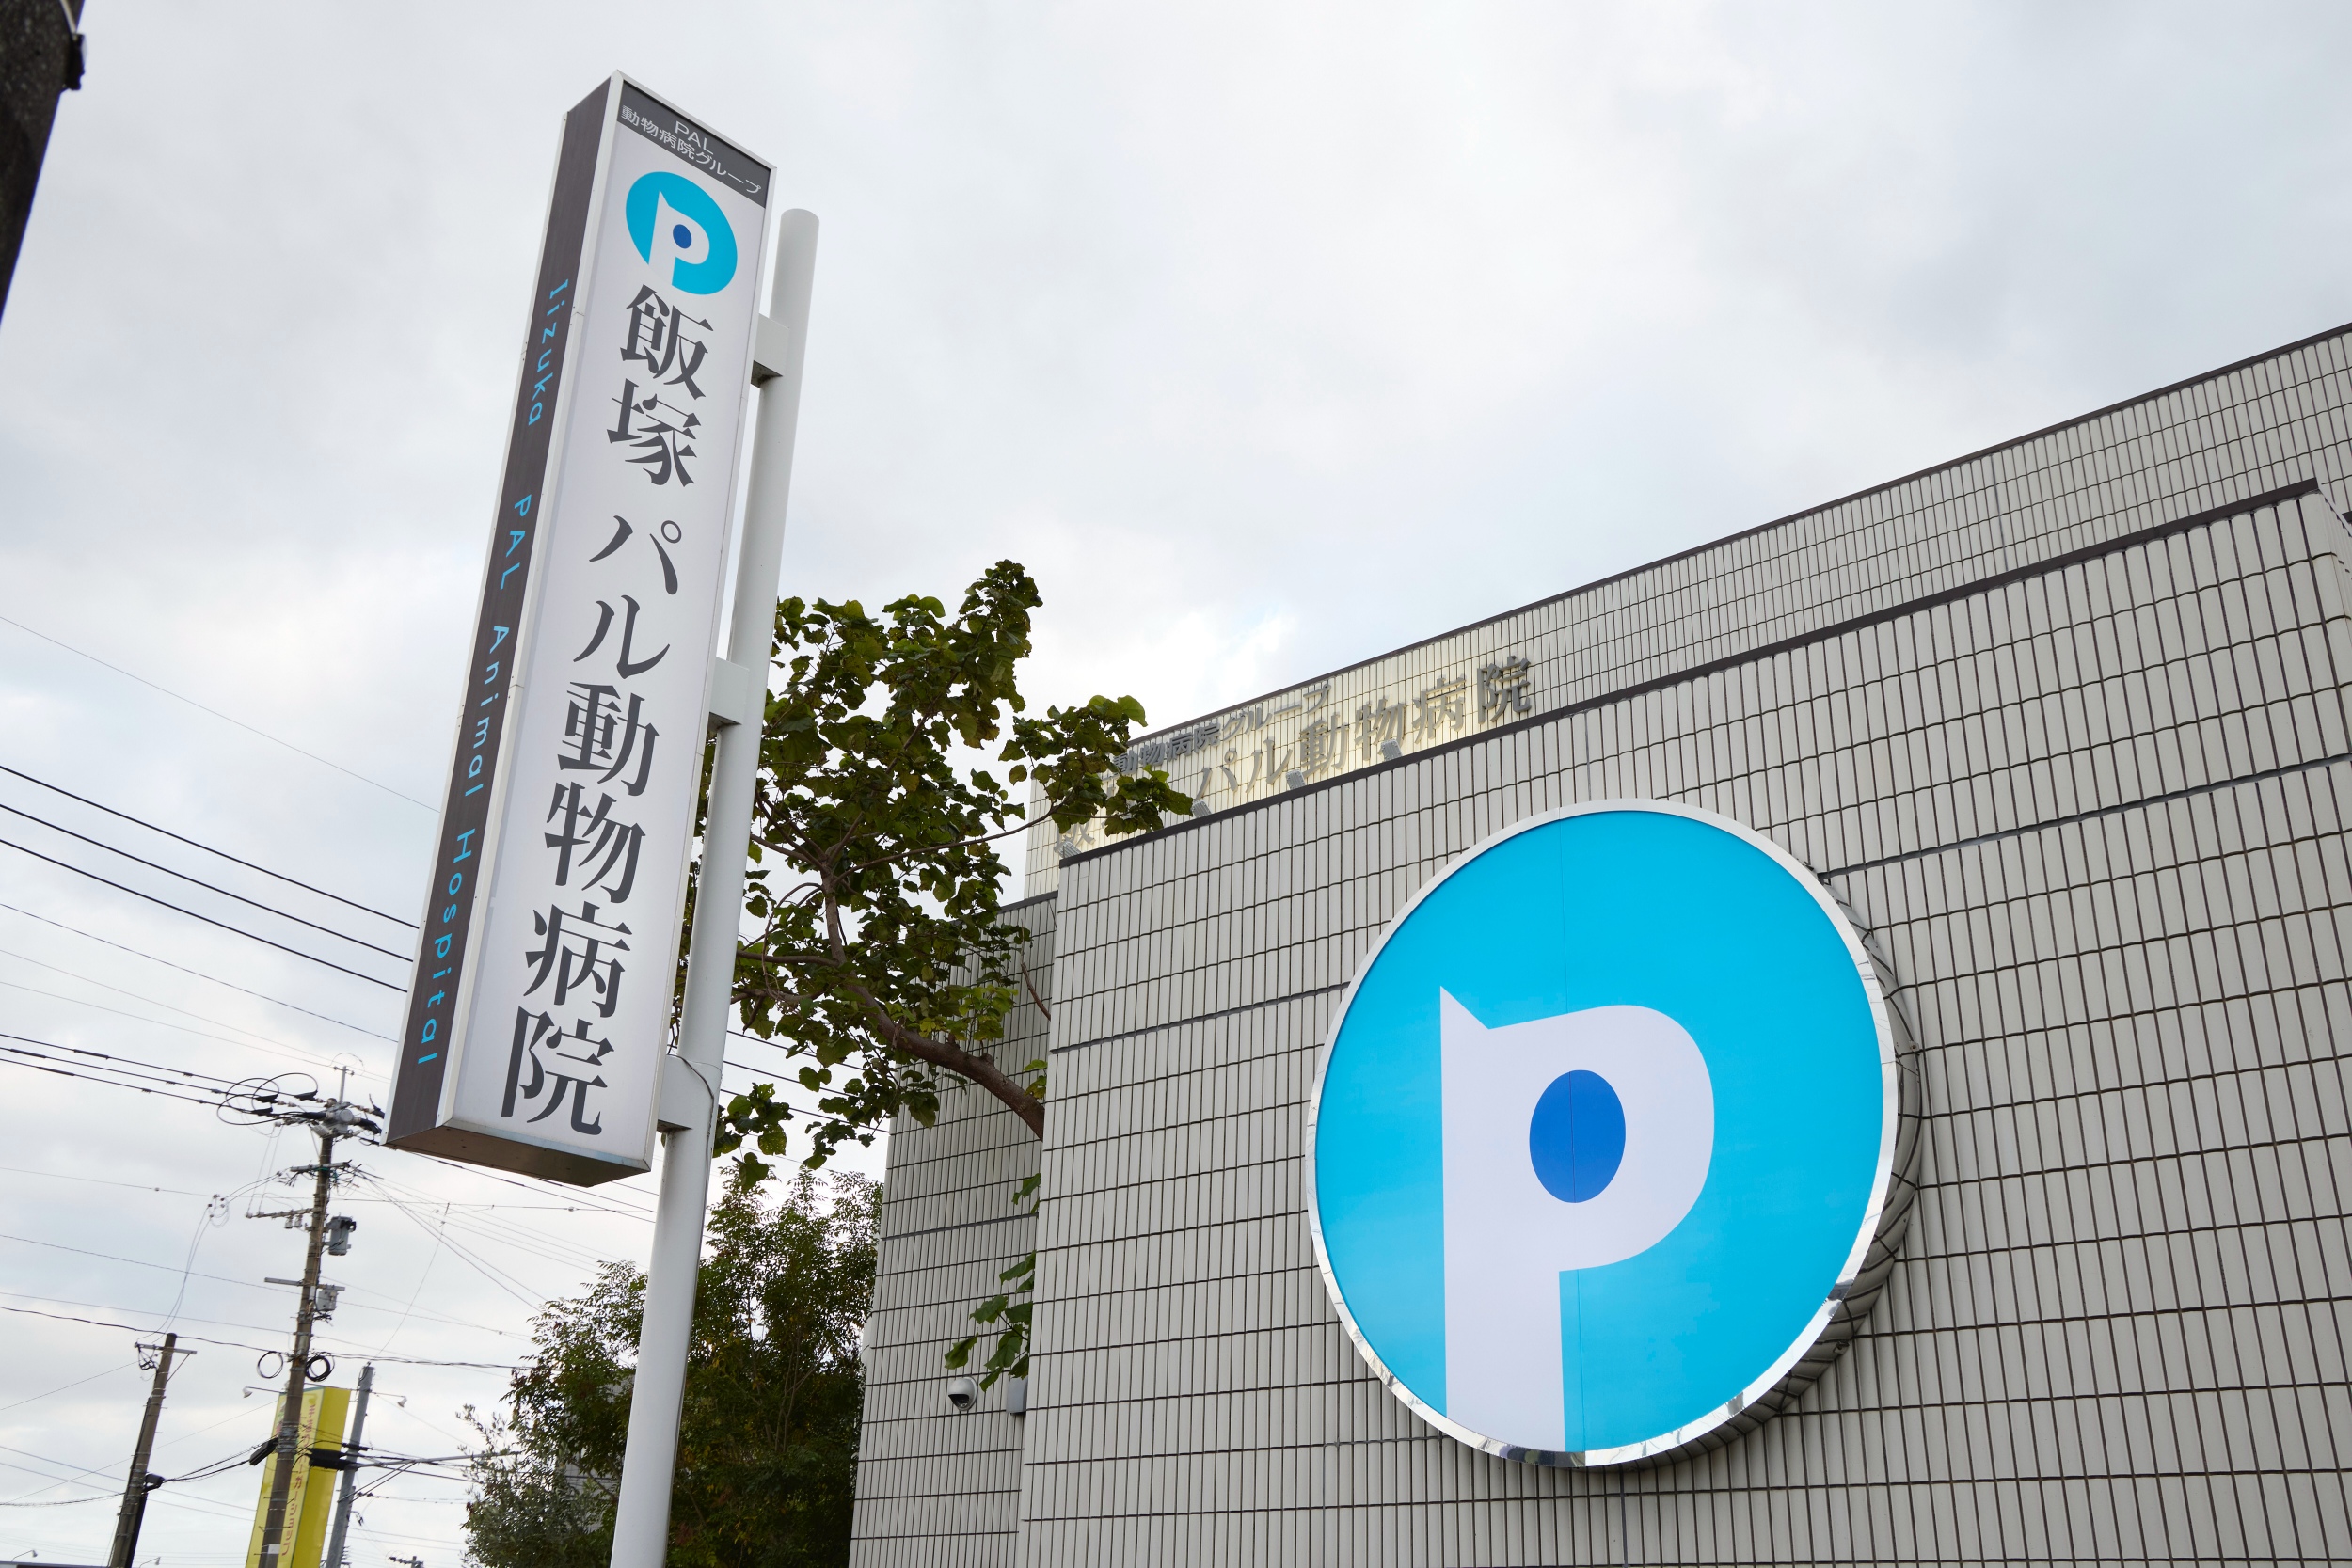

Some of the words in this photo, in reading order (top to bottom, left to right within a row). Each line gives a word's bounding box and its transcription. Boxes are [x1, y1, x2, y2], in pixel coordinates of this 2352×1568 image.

[621, 105, 762, 194] 動物病院グループ
[675, 120, 713, 155] PAL
[528, 278, 568, 426] Iizuka
[500, 494, 532, 590] PAL
[464, 626, 510, 797] Animal
[1112, 684, 1332, 776] 動物病院グループ
[418, 828, 476, 1065] Hospital
